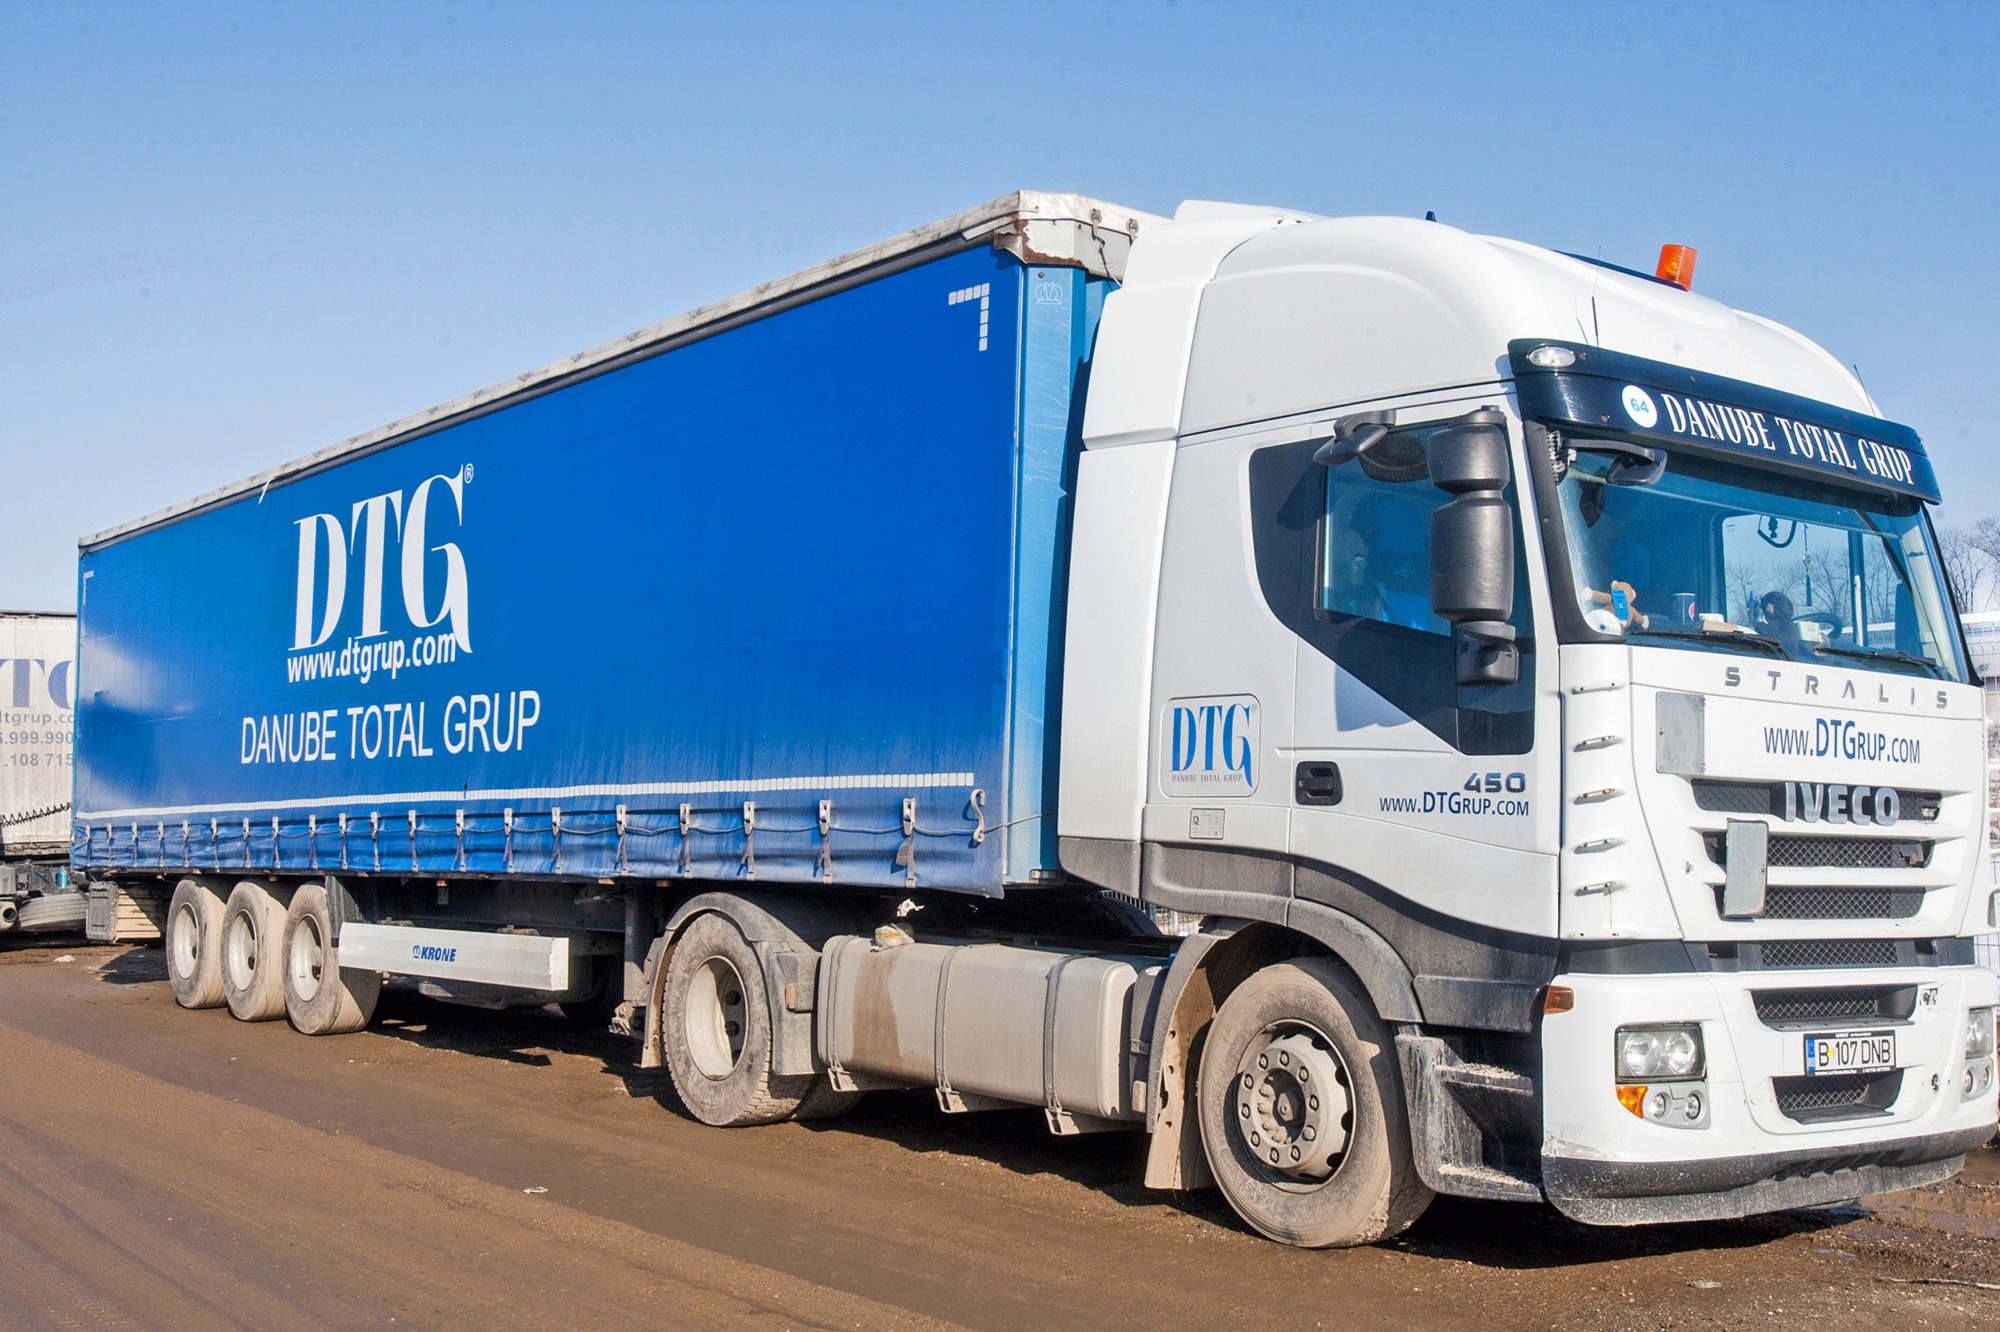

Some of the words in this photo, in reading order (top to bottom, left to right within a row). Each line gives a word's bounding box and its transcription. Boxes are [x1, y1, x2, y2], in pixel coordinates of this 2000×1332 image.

[1630, 398, 1649, 414] 64
[1661, 393, 1776, 451] DANUBE
[1775, 416, 1857, 470] TOTAL
[1858, 438, 1914, 485] GRUP
[288, 464, 473, 653] DTG
[287, 632, 456, 684] www.dtgrup.com
[1725, 666, 1948, 709] STRALIS
[241, 709, 338, 764] DANUBE
[346, 702, 433, 759] TOTAL
[443, 690, 541, 754] GRUP
[1169, 703, 1254, 788] DTG
[1172, 774, 1197, 783] DANUBE
[1200, 774, 1220, 783] TOTAL
[1224, 774, 1243, 783] GRUP
[1463, 772, 1526, 793] 450
[1783, 781, 1900, 827] IVECO
[420, 945, 457, 962] KRONE
[1818, 1042, 1829, 1066] B
[1835, 1041, 1858, 1065] 107
[1861, 1039, 1891, 1064] DNB
